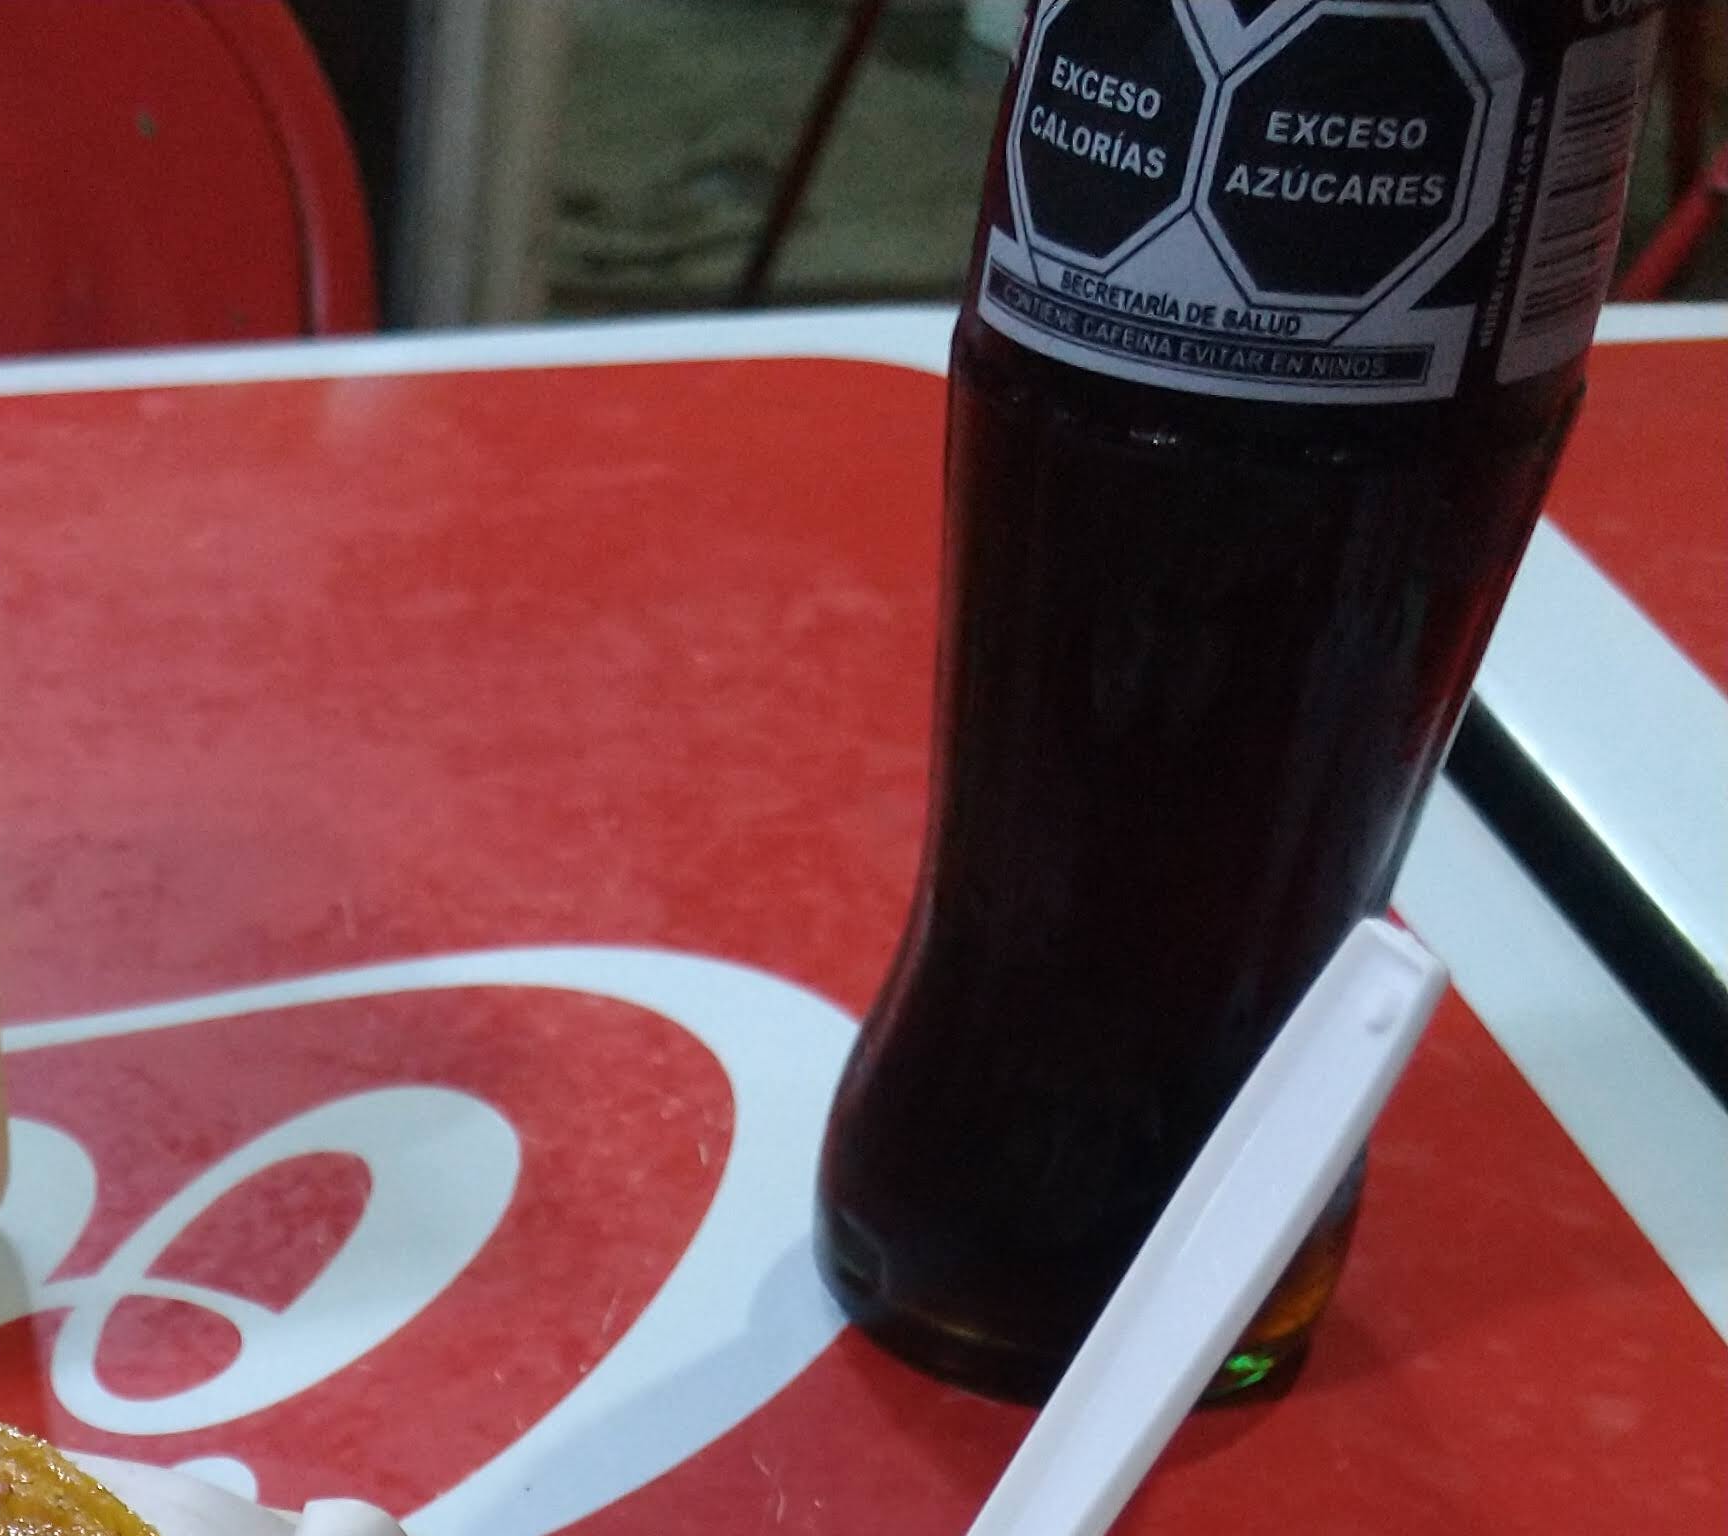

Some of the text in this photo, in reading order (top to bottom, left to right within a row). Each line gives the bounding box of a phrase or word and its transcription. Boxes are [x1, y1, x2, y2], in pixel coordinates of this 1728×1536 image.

[1050, 55, 1163, 120] EXCESO
[1029, 104, 1167, 180] CALORÍAS
[1265, 110, 1428, 151] EXCESO
[1224, 163, 1446, 207] AZÚCARES
[1060, 267, 1302, 338] SECRETARÍA DE SALUD
[1179, 337, 1265, 373] EVITAR
[1271, 348, 1304, 375] EN
